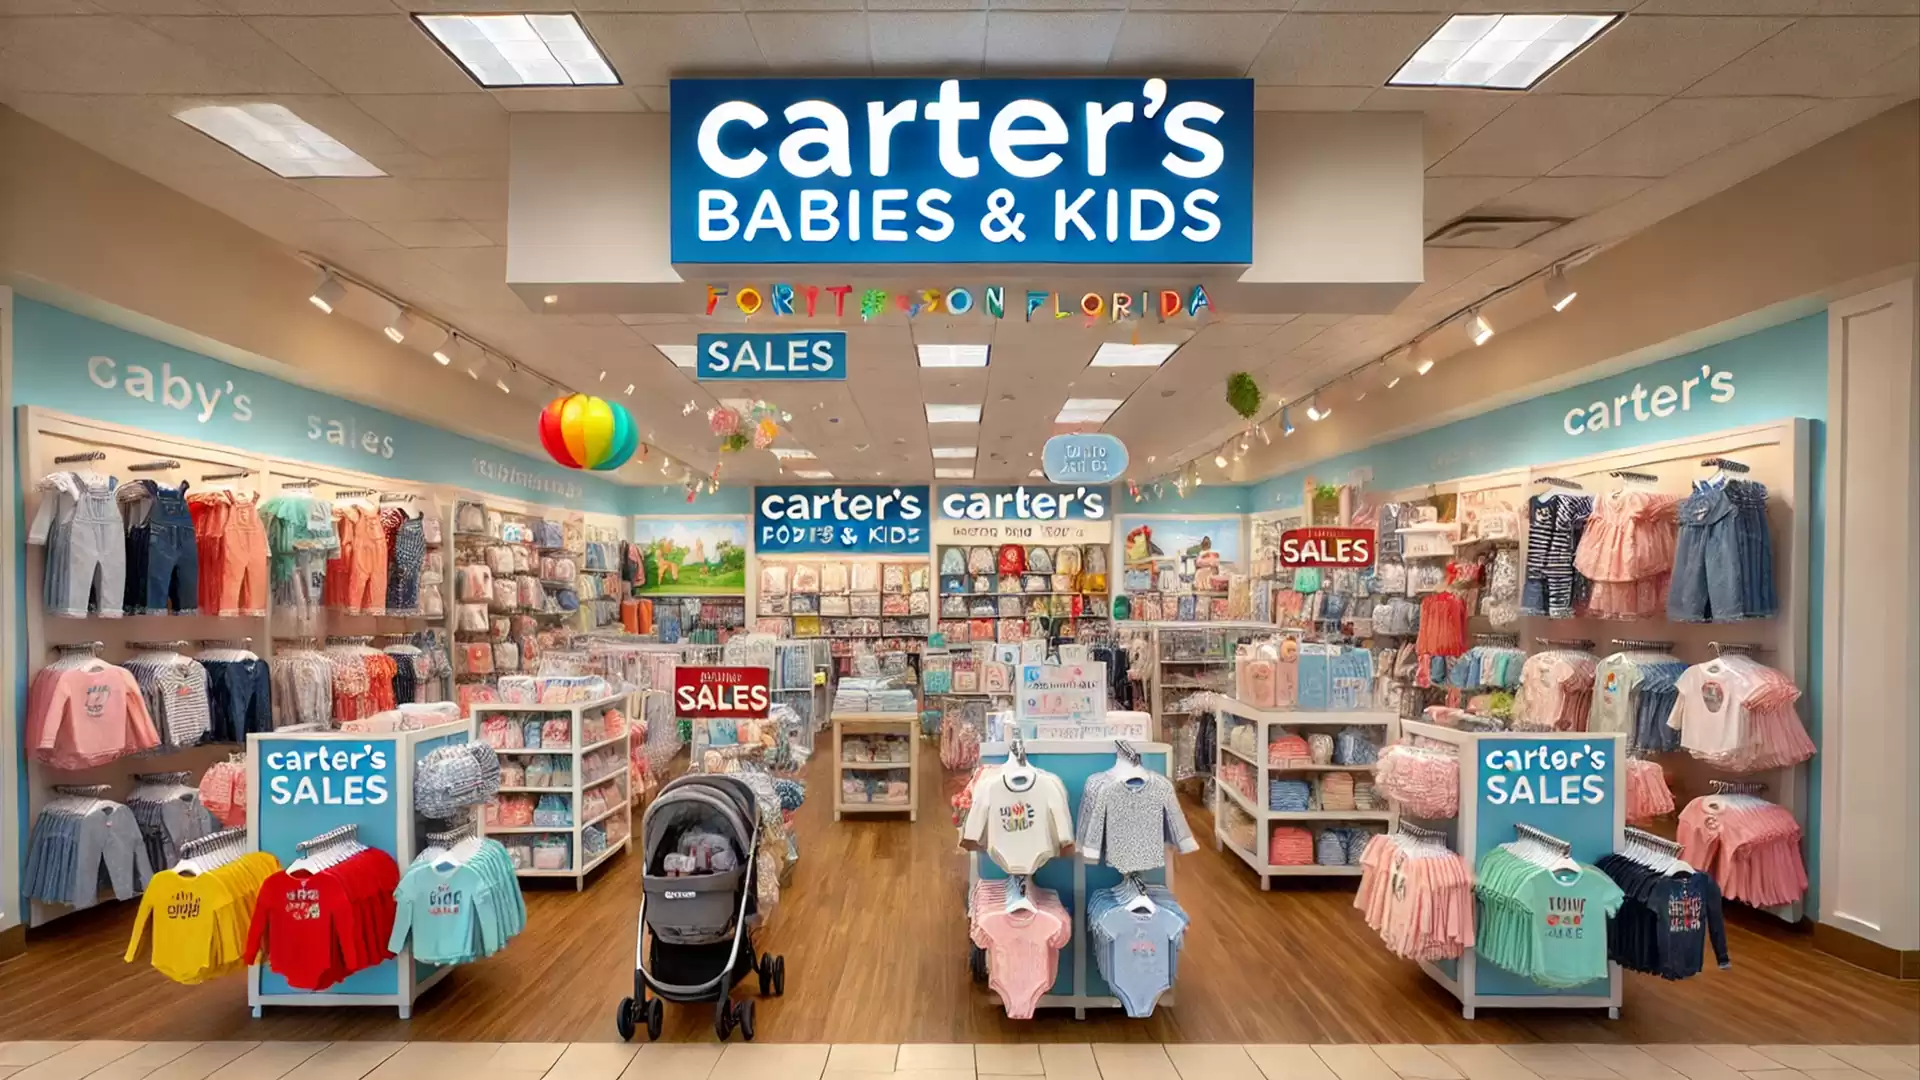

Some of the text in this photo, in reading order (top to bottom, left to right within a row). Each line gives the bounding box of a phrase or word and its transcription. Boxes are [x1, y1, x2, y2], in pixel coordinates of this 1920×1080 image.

[697, 78, 1225, 178] carter's
[697, 188, 1222, 243] BABIES & KIDS
[1026, 284, 1216, 322] FLORIDA
[708, 340, 834, 372] SALES
[87, 355, 395, 459] caby's sales
[1563, 365, 1736, 436] carter's
[761, 488, 922, 521] carter's
[942, 486, 1105, 519] carter's
[1283, 538, 1369, 562] SALES
[677, 684, 768, 711] SALES
[266, 744, 387, 771] carter's
[271, 775, 388, 805] SALES
[1486, 775, 1605, 805] SALES
